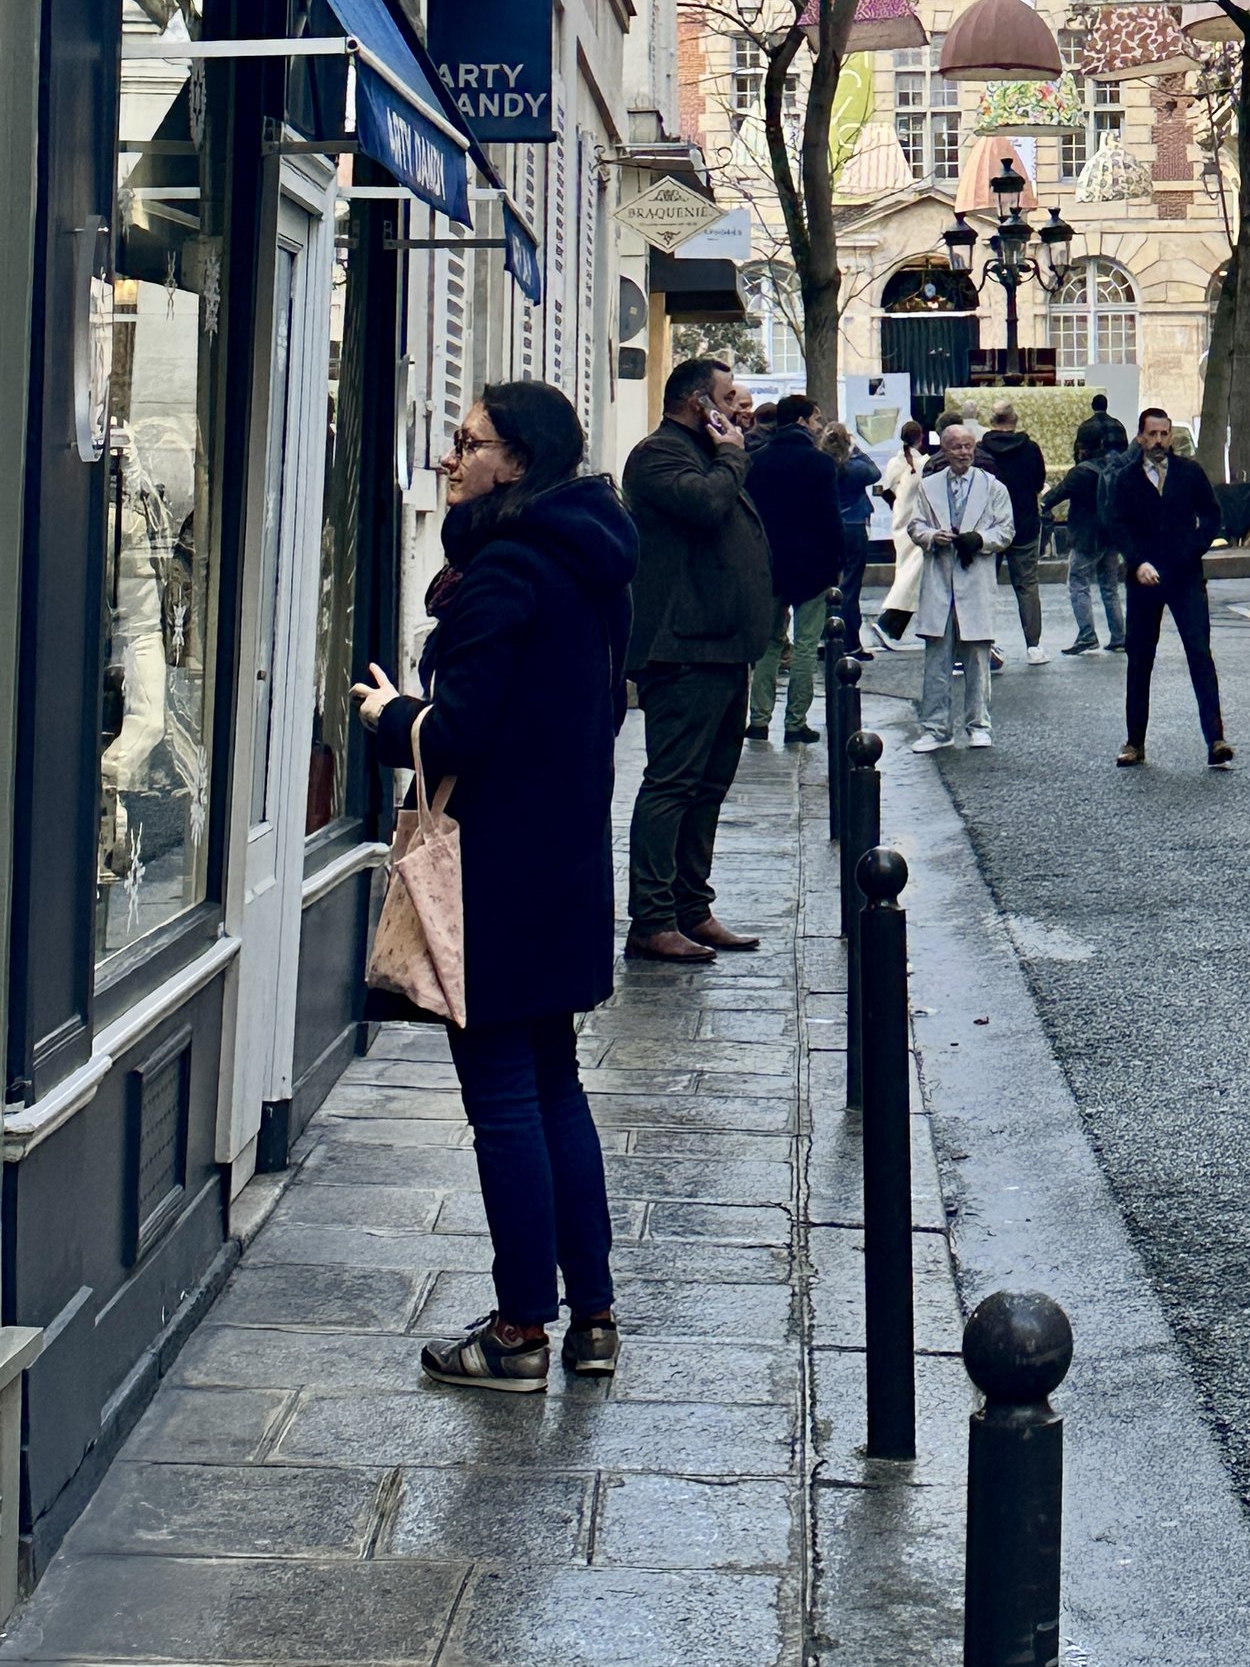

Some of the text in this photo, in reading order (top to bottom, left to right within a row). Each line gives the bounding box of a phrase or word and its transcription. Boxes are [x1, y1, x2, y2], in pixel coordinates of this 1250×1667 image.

[437, 63, 524, 88] ARTY
[457, 92, 547, 118] ANDY
[386, 106, 413, 176] ARTY
